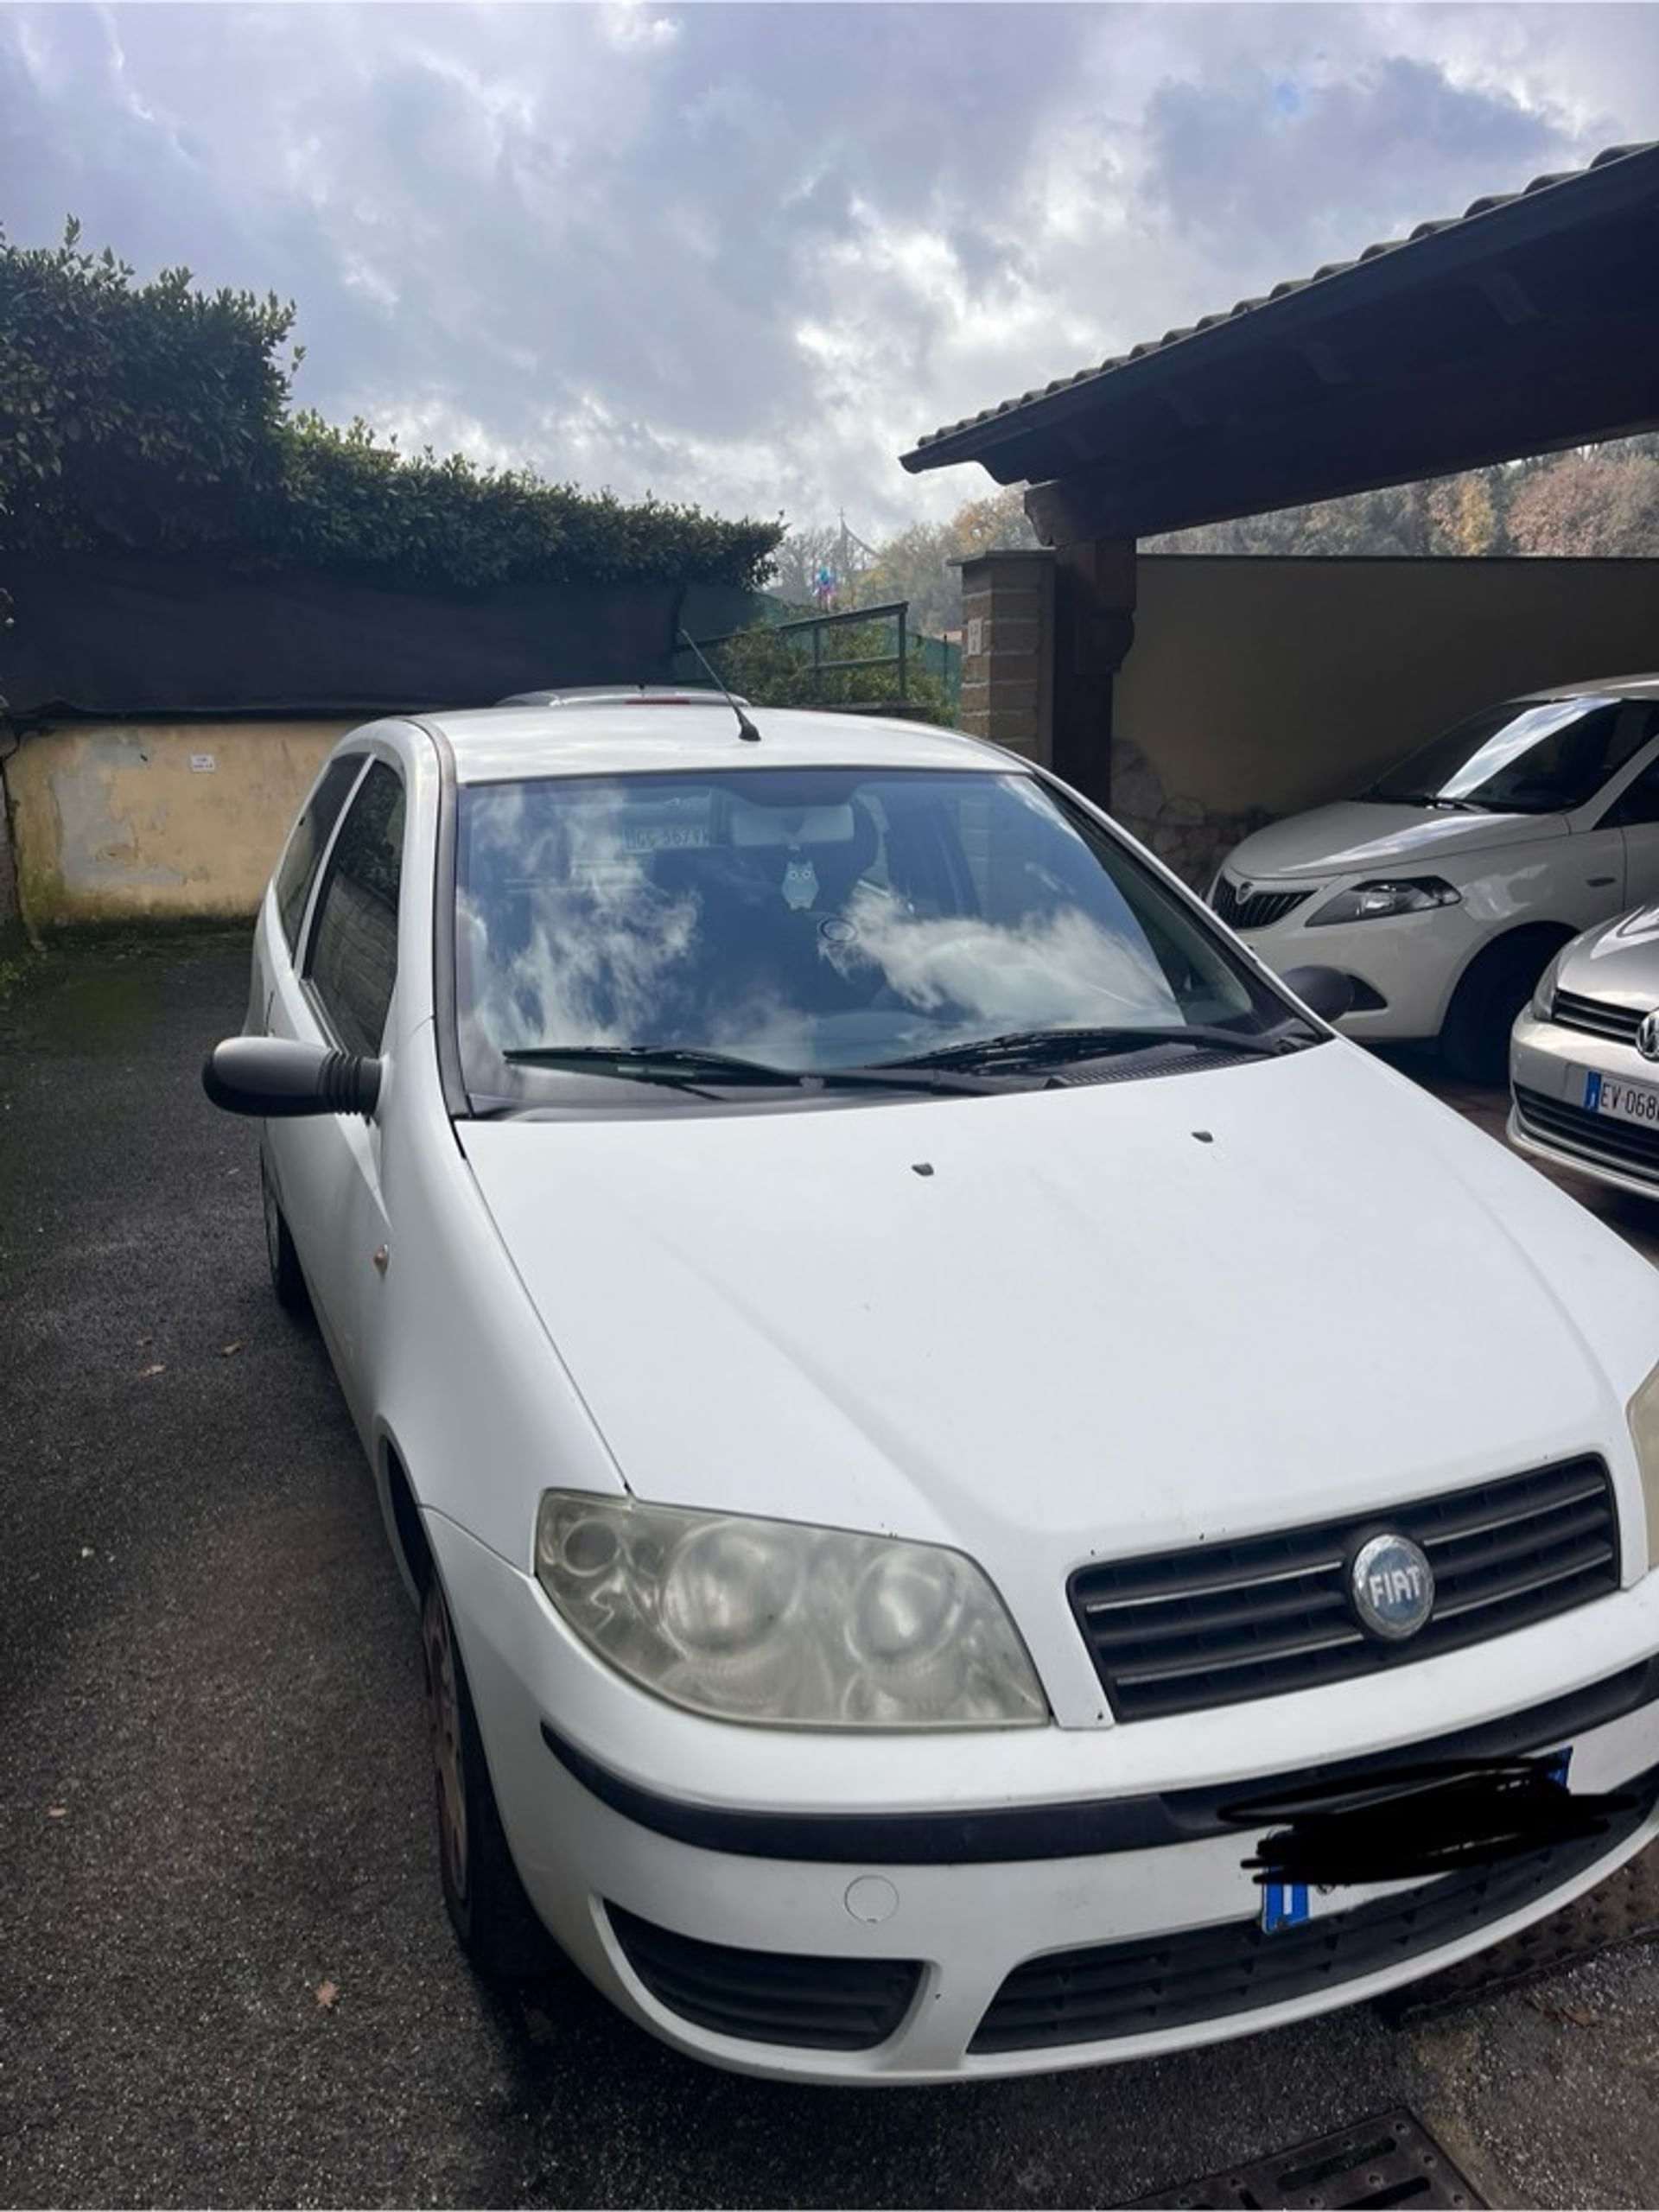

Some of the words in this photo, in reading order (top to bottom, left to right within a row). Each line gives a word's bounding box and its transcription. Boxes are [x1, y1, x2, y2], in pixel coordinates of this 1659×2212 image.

[1601, 1083, 1621, 1109] EV
[1625, 1090, 1659, 1122] 068
[1369, 1565, 1421, 1608] FIAT
